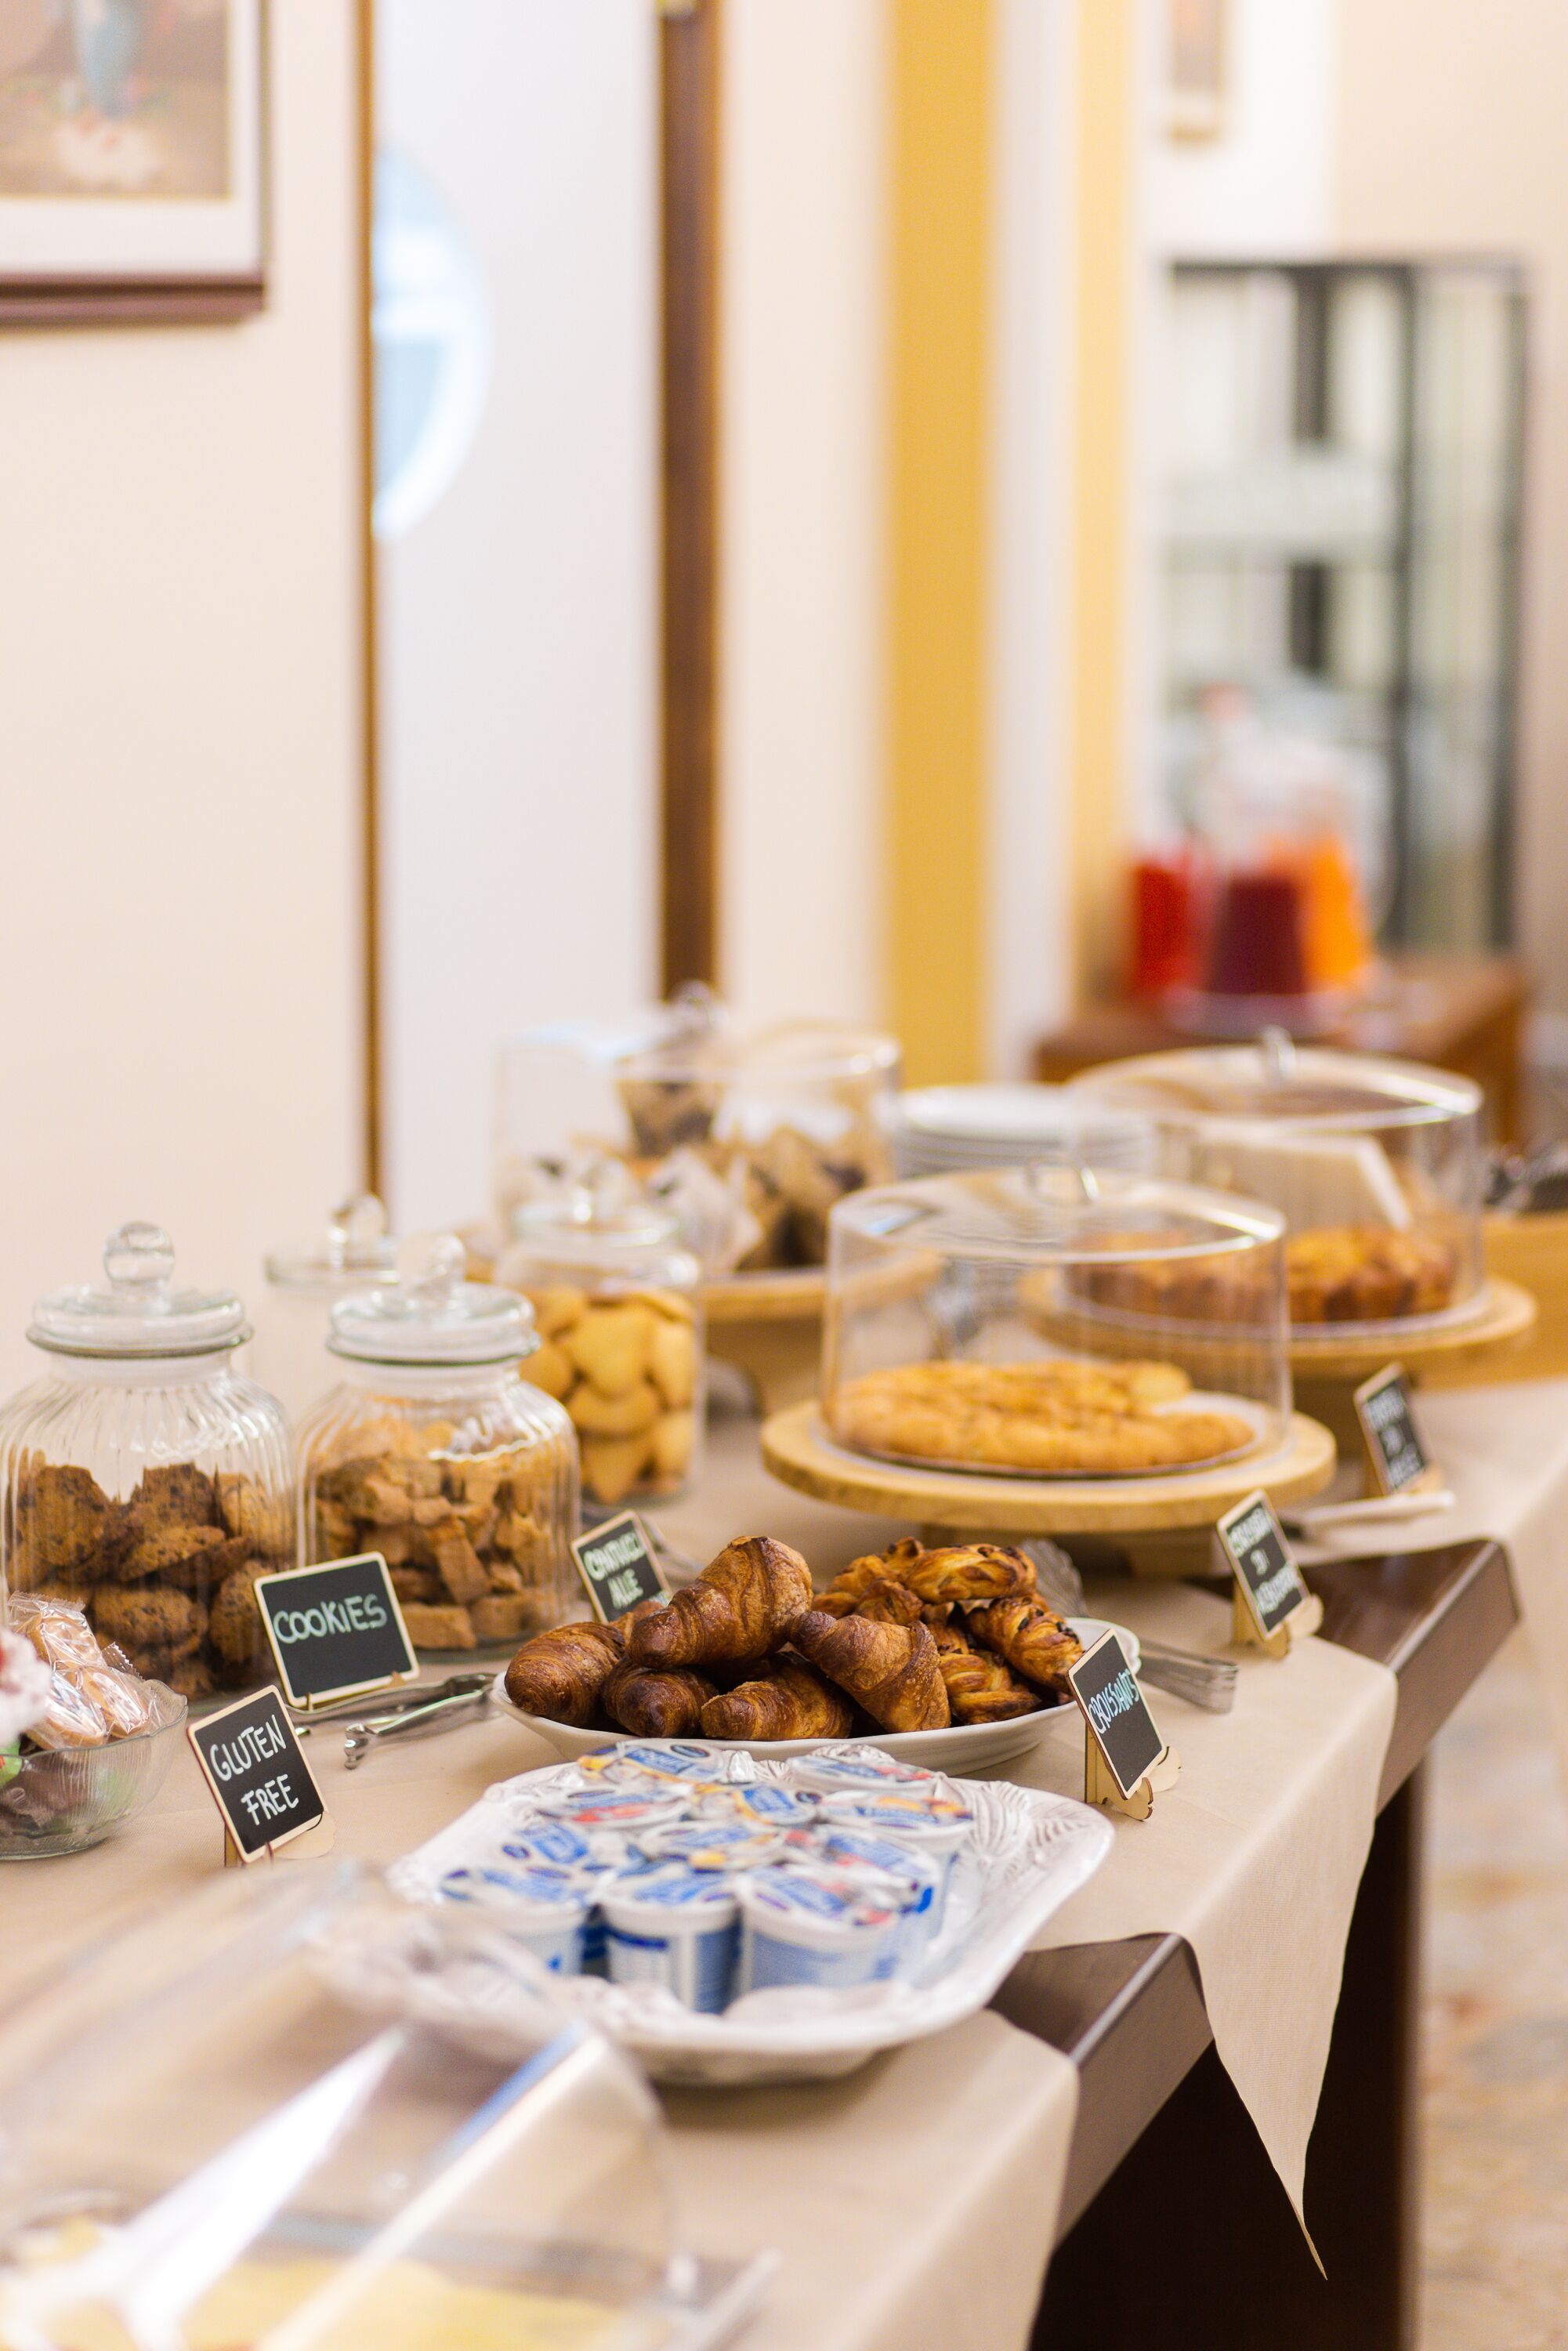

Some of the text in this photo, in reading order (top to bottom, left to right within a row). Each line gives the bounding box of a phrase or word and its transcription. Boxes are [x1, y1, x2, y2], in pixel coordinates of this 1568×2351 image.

[272, 1592, 388, 1644] COOKIES
[1088, 1668, 1139, 1734] CROISSANTS
[209, 1714, 287, 1781] GLUTEN
[240, 1773, 299, 1826] FREE
